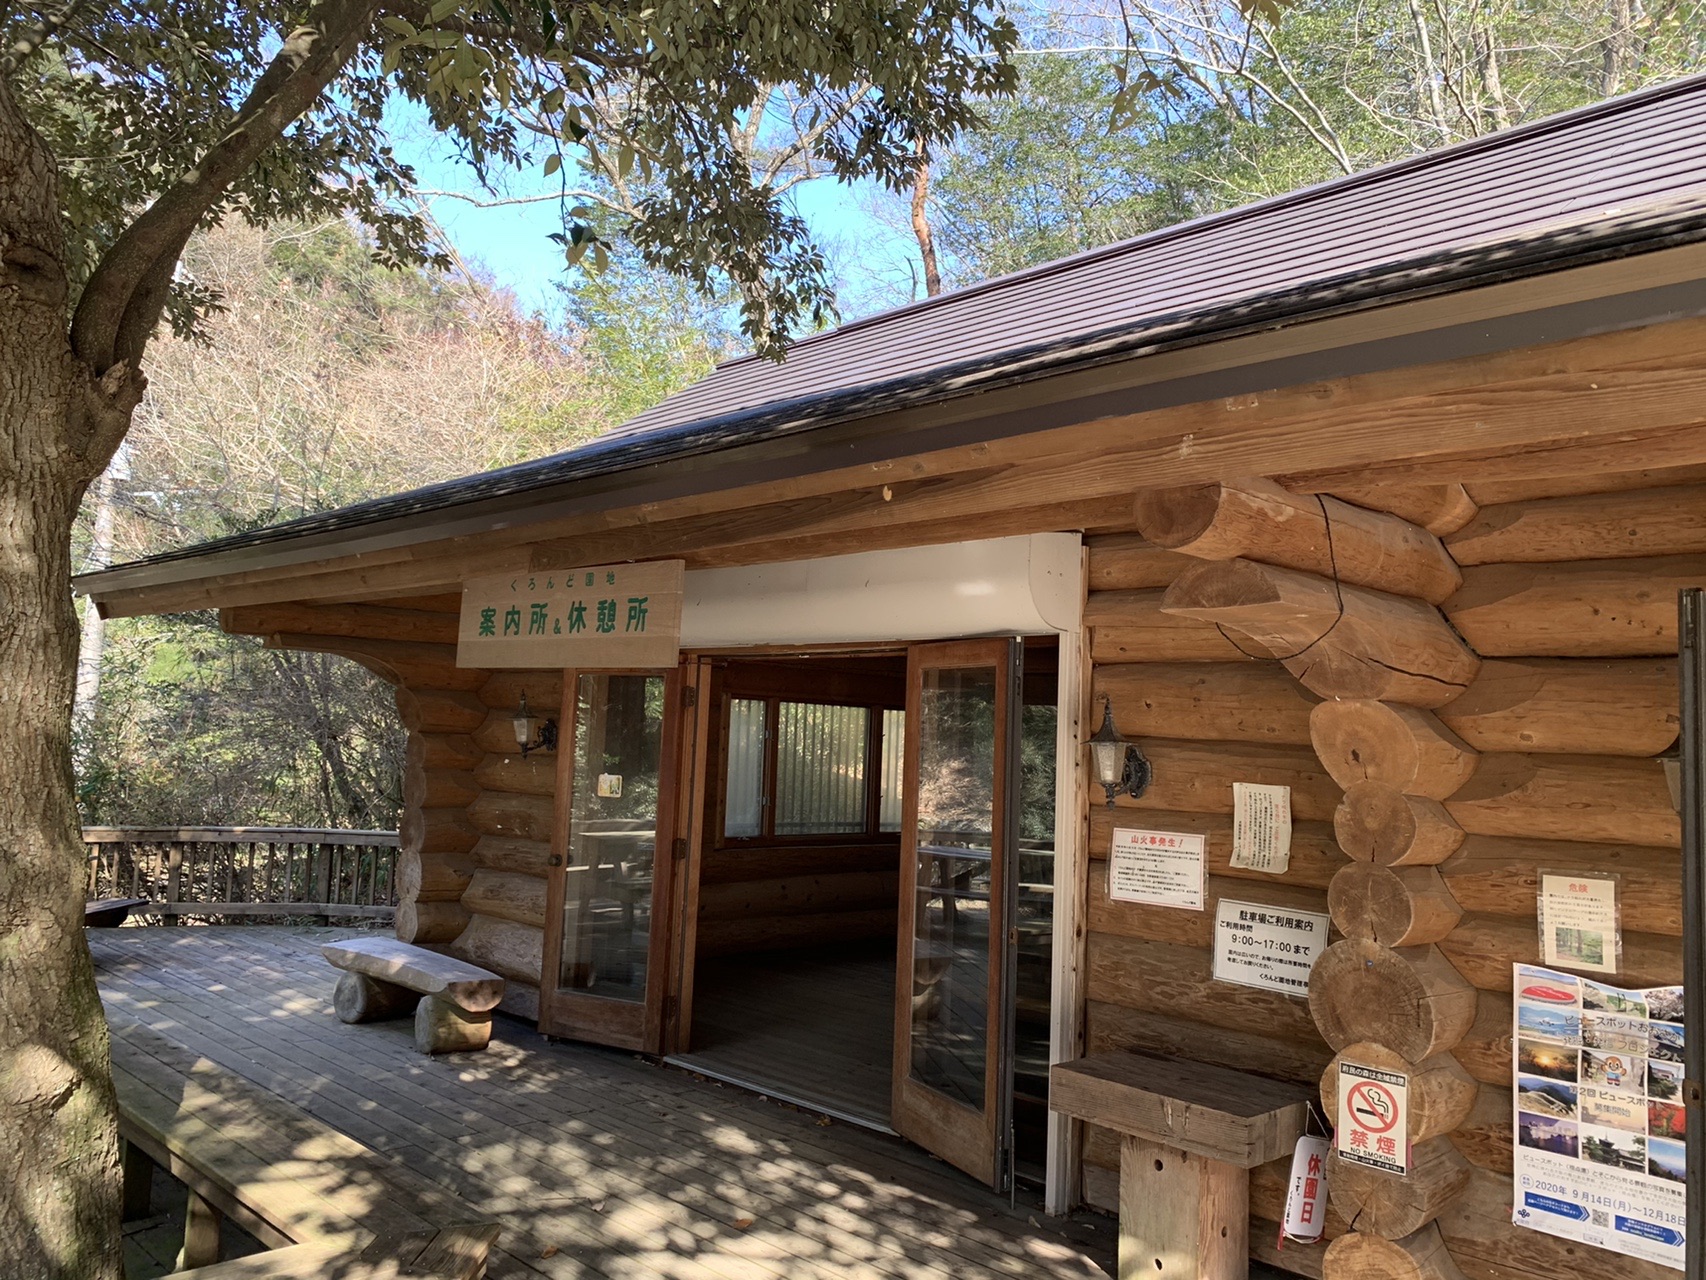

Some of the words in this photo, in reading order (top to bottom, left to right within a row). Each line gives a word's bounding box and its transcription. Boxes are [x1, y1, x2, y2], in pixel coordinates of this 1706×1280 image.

[510, 571, 616, 592] くろんど園地
[478, 597, 649, 637] 案内所&休憩所
[1569, 883, 1588, 893] 危険
[1219, 920, 1253, 933] ご利用時間
[1239, 909, 1314, 932] 駐車場ご利用案内
[1564, 1014, 1681, 1043] ビュースポットおおさか
[1341, 1065, 1405, 1086] 府民の森は全域禁煙
[1349, 1128, 1397, 1157] 禁煙
[1350, 1146, 1361, 1155] NO
[1362, 1150, 1397, 1164] SMOKING
